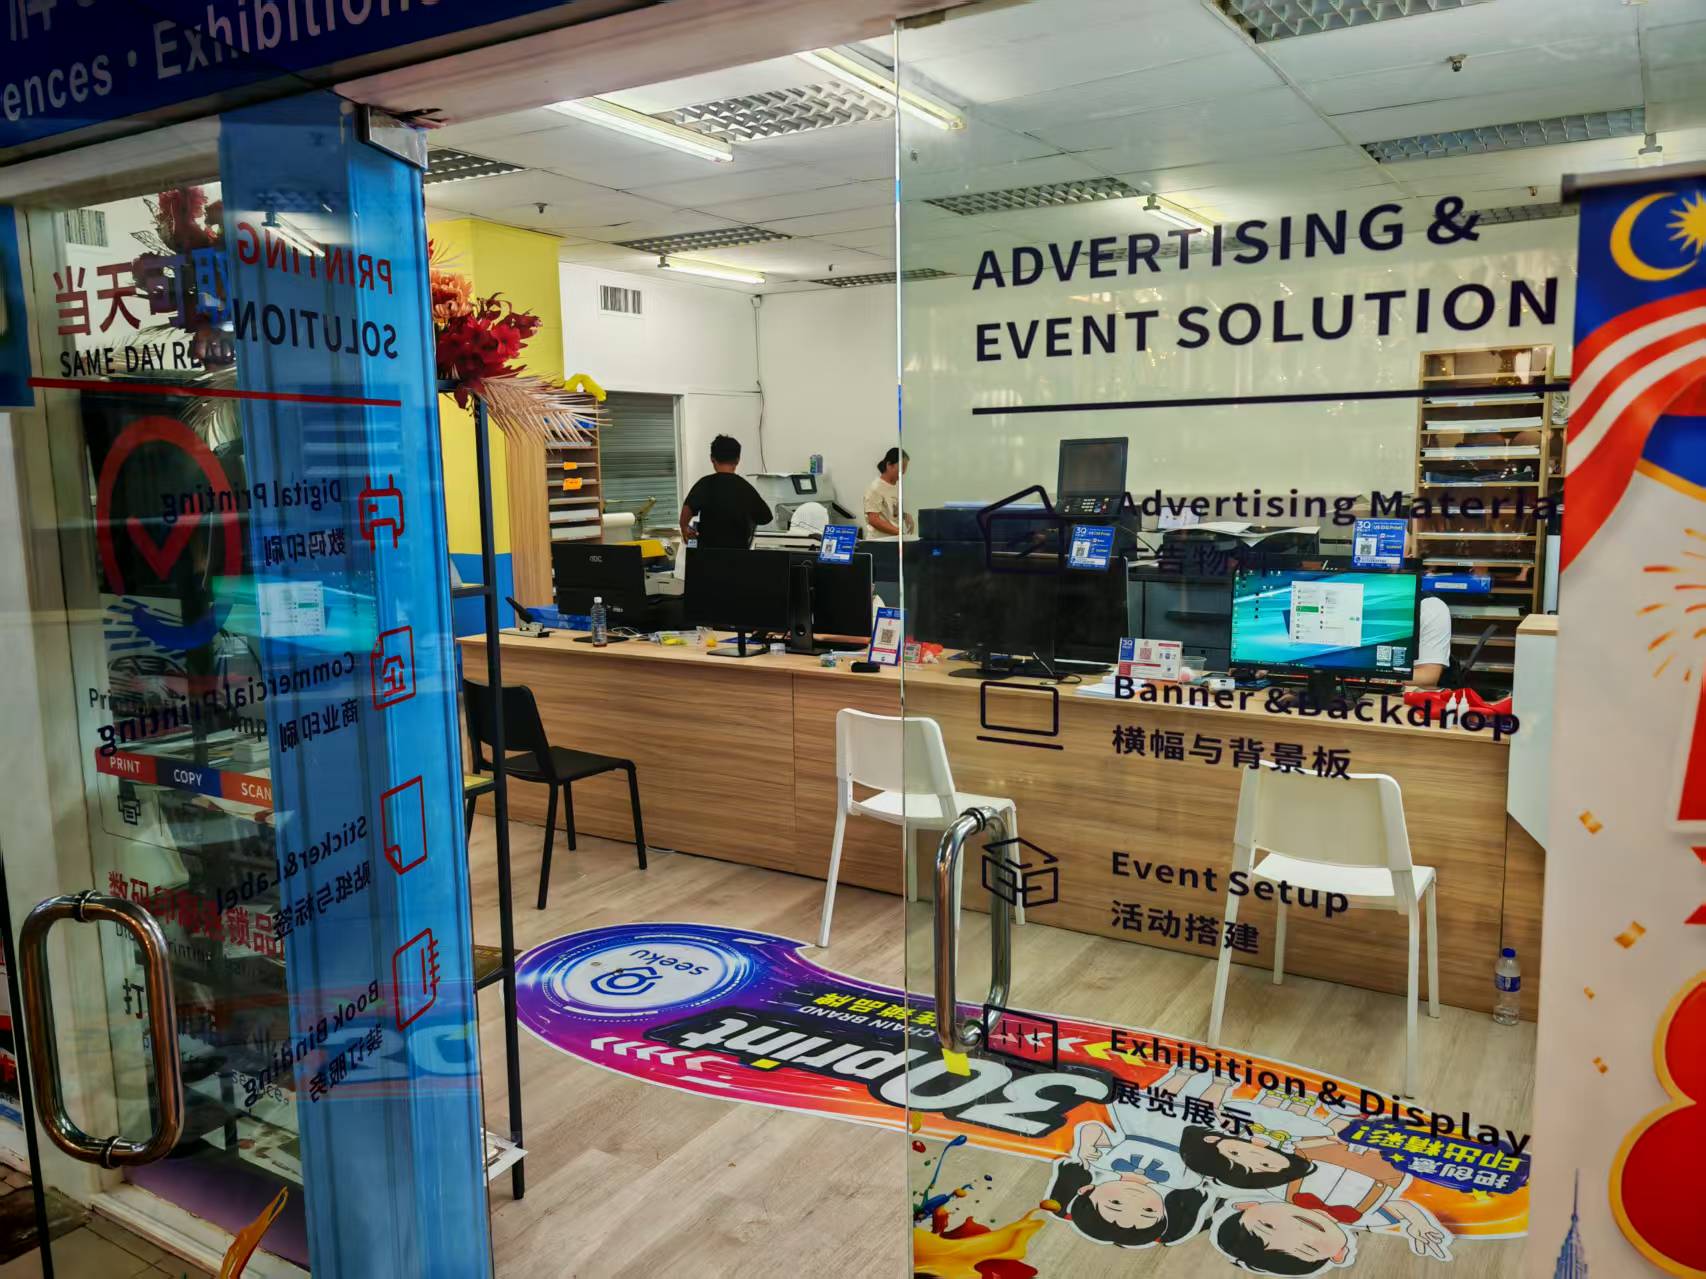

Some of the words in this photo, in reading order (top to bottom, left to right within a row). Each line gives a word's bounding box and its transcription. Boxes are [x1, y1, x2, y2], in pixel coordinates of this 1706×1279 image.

[0, 54, 113, 121] ences
[153, 0, 442, 79] Exhibitio
[972, 203, 1405, 290] ADVERTISING
[1427, 196, 1480, 243] &
[976, 310, 1158, 362] EVENT
[1176, 277, 1559, 349] SOLUTION
[60, 349, 115, 378] SAME
[125, 343, 165, 372] DAY
[1120, 489, 1356, 526] Advertising
[1114, 676, 1255, 711] Banner
[109, 757, 140, 774] PRINT
[1112, 724, 1352, 780] 横幅与背景板
[173, 769, 203, 786] COPY
[241, 782, 272, 801] SCAN
[1111, 851, 1218, 892] Event
[1228, 871, 1349, 918] Setup
[1111, 899, 1260, 955] 活动搭建
[628, 946, 711, 977] seeku
[798, 1005, 866, 1027] BRAND
[1110, 1029, 1306, 1098] Exhibition
[1318, 1080, 1346, 1109] &
[1359, 1088, 1531, 1156] Display
[1112, 1077, 1255, 1137] 展览展示
